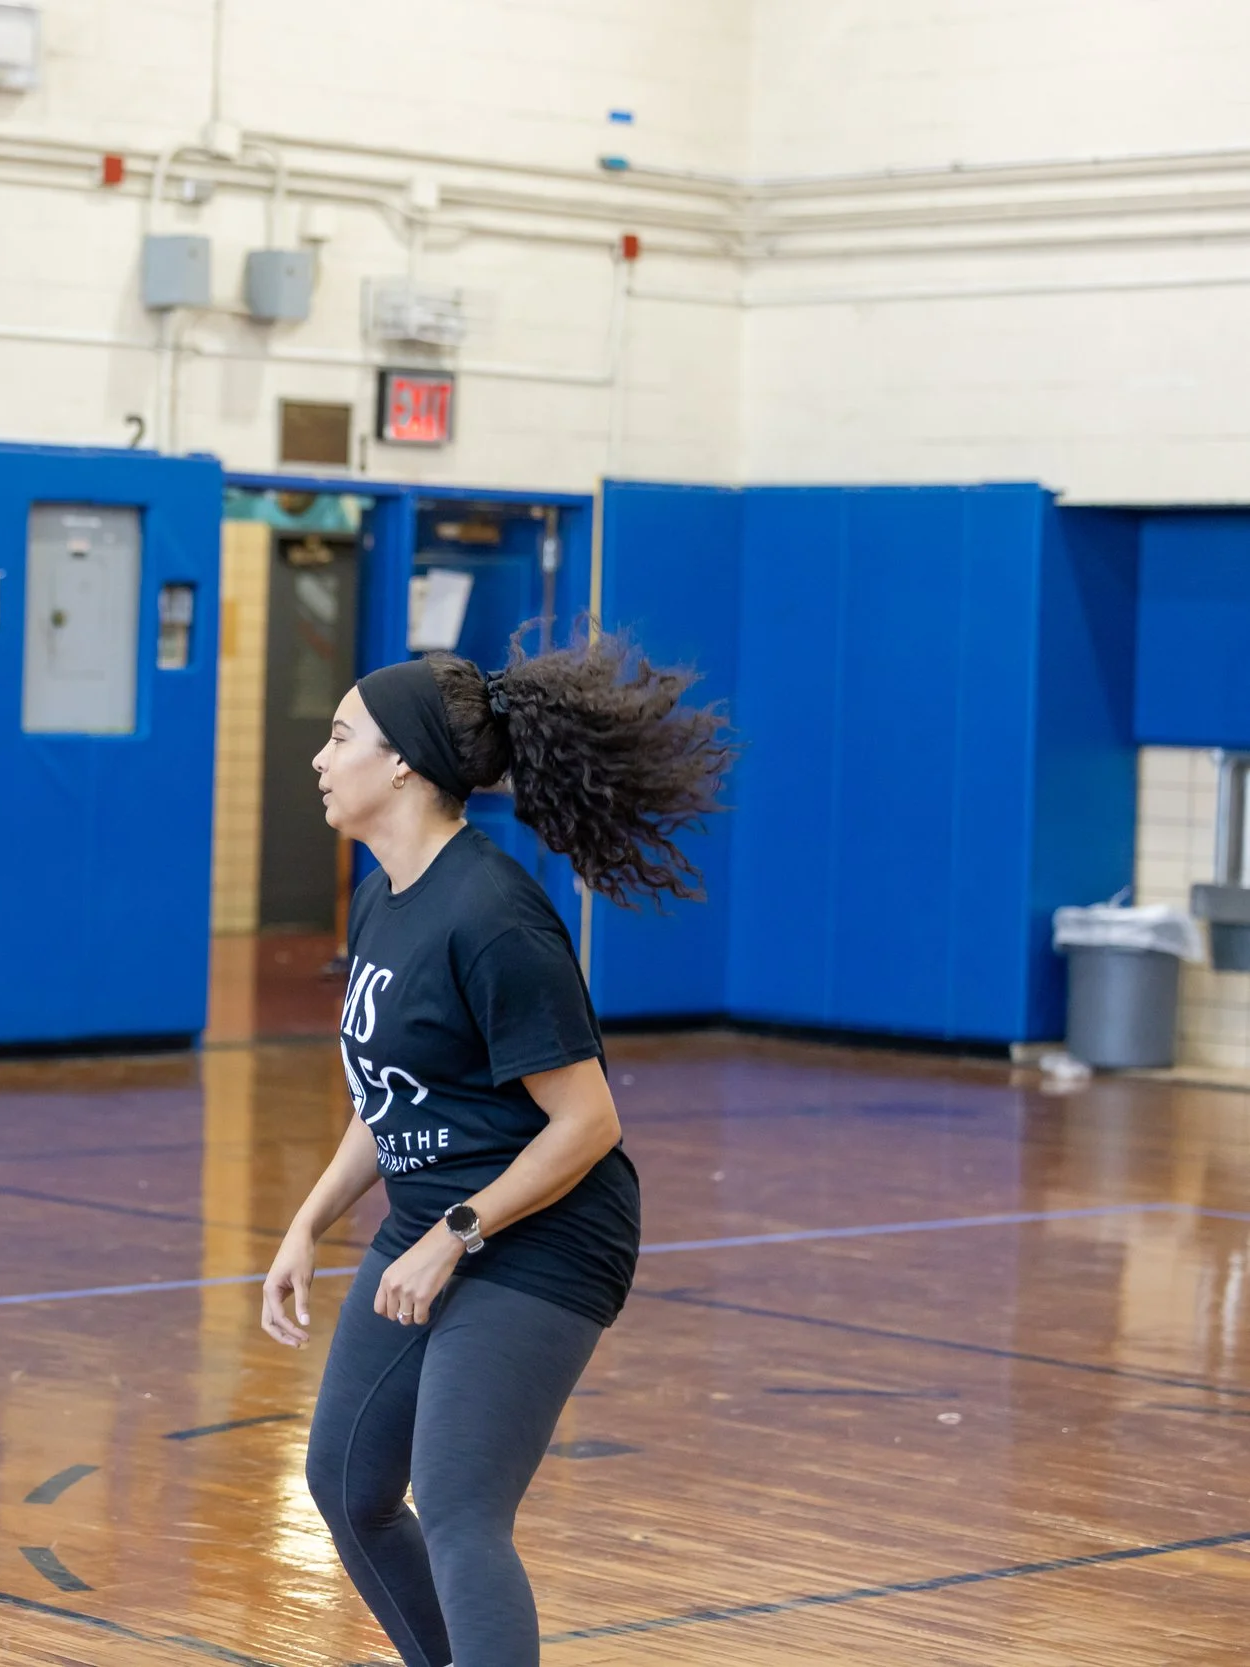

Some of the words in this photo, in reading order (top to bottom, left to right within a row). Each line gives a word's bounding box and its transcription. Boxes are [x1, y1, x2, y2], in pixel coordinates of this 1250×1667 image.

[392, 378, 452, 440] EXIT
[376, 1133, 396, 1152] OF
[402, 1128, 449, 1151] THE
